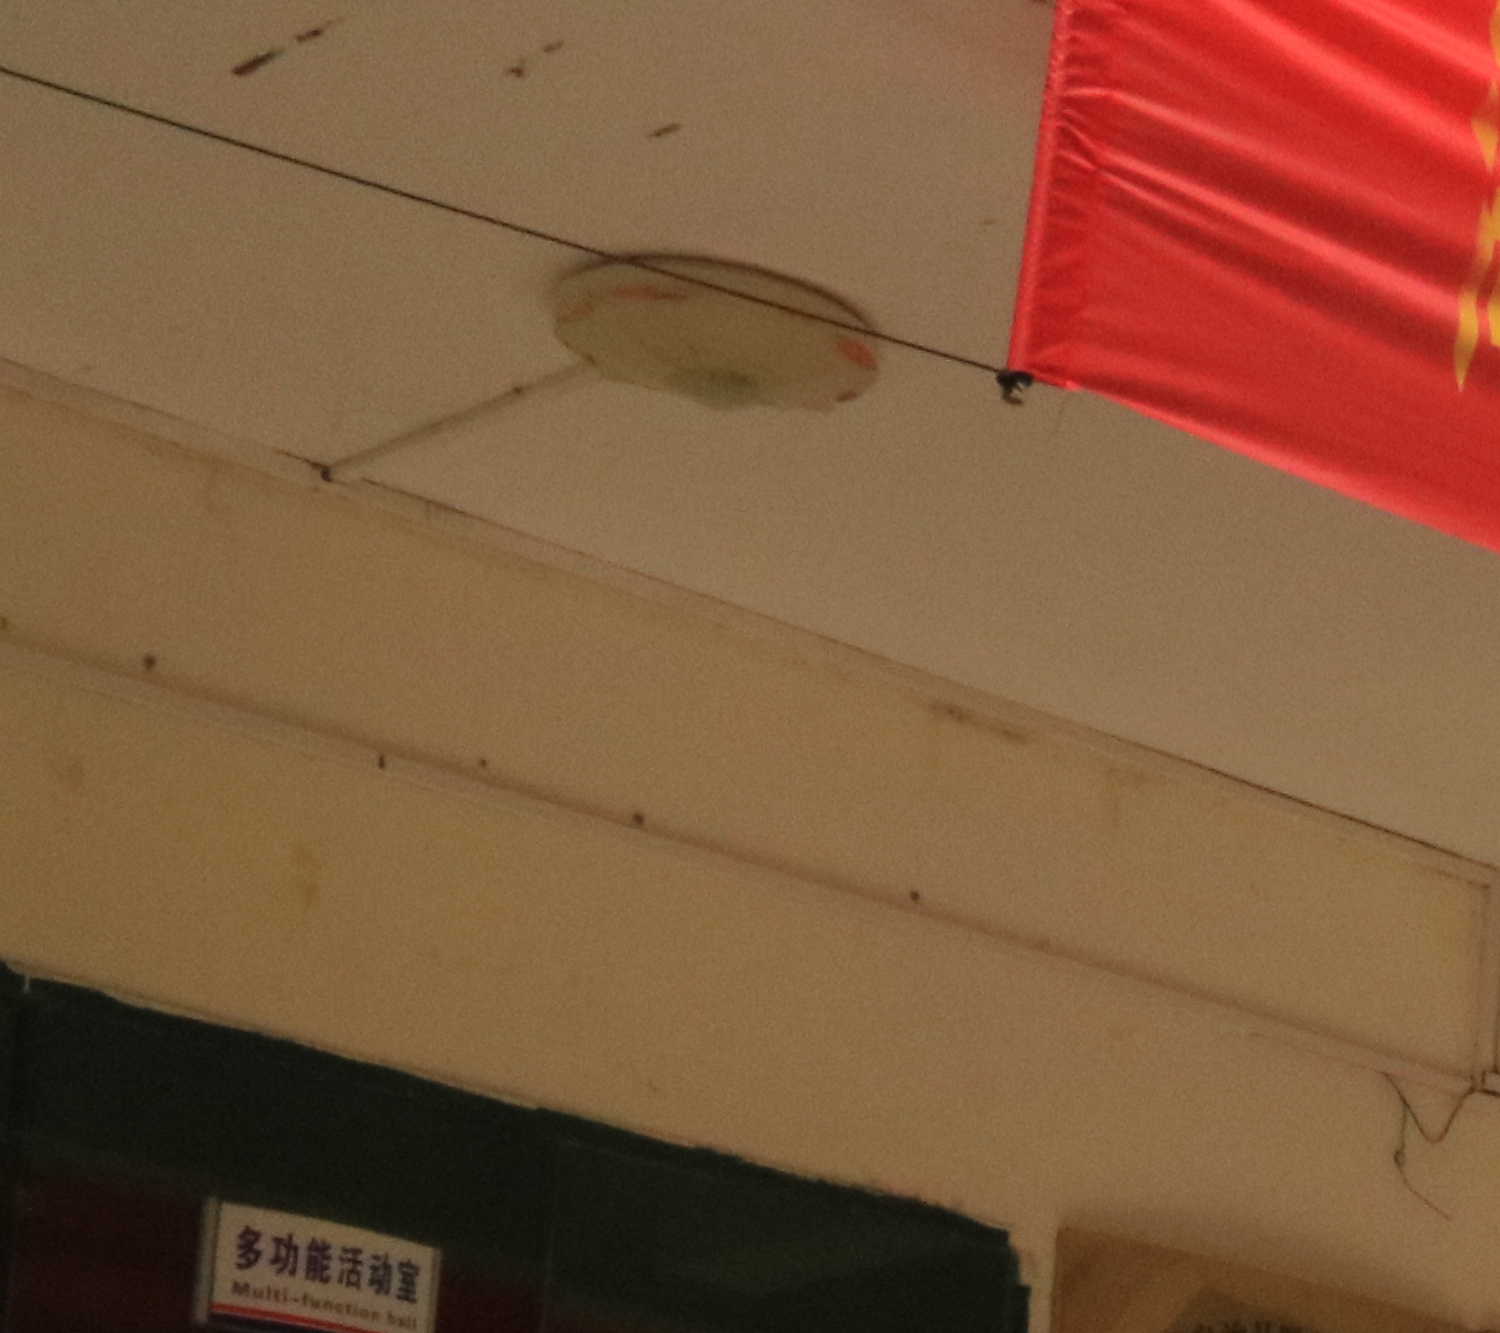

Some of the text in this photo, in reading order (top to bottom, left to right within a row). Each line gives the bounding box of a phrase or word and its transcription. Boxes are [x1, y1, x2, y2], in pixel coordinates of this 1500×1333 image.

[235, 1225, 420, 1304] 多功能活动室
[234, 1281, 381, 1320] Multi-function
